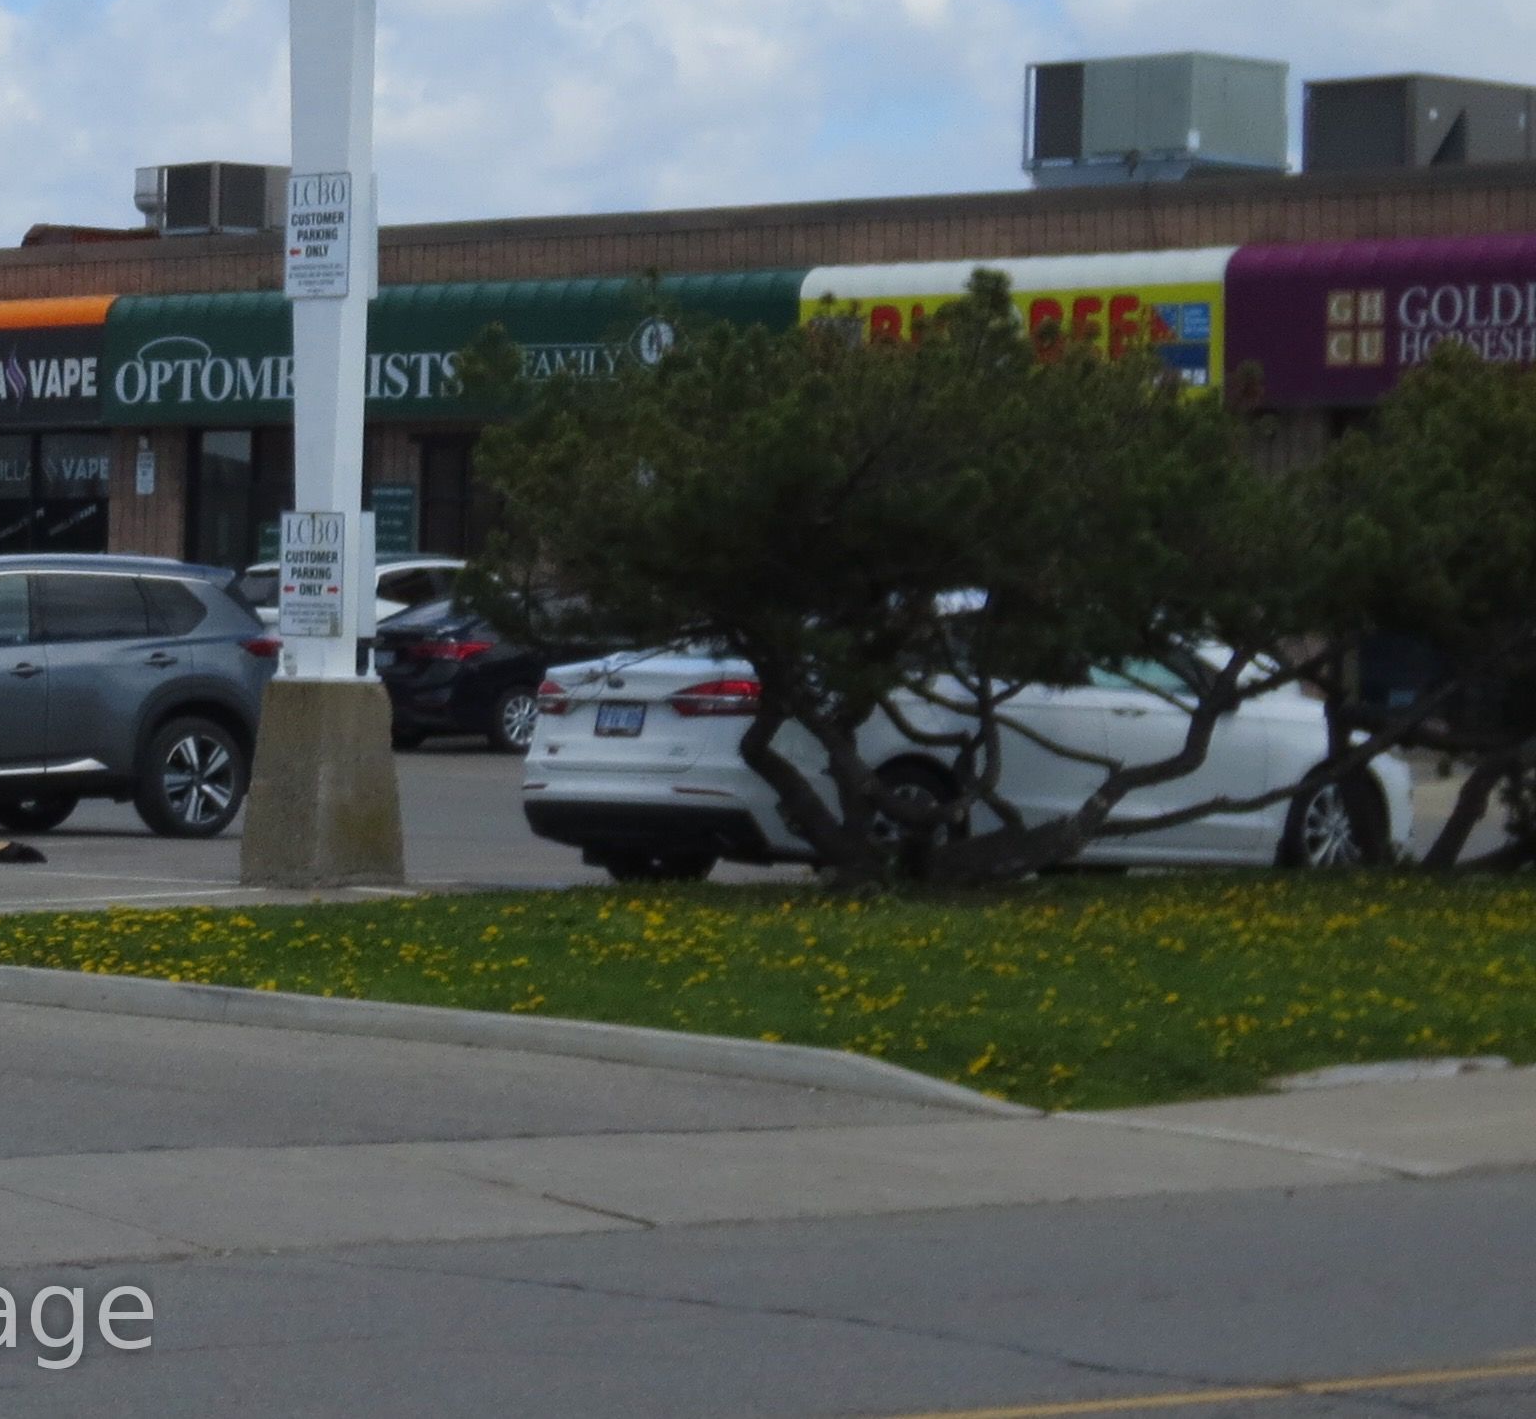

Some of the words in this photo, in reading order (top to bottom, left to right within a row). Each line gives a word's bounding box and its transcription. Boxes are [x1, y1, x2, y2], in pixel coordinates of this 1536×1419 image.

[292, 178, 346, 207] LCBO
[290, 211, 345, 227] CUSTOMER
[296, 227, 339, 242] PARKING
[305, 244, 329, 258] ONLY
[29, 357, 98, 400] VAPE
[115, 349, 466, 405] OPTOMEISTS
[61, 456, 110, 480] VAPE
[285, 518, 339, 545] LCBO
[285, 549, 339, 564] CUSTOMER
[291, 565, 332, 580] PARKING
[299, 583, 324, 596] ONLY
